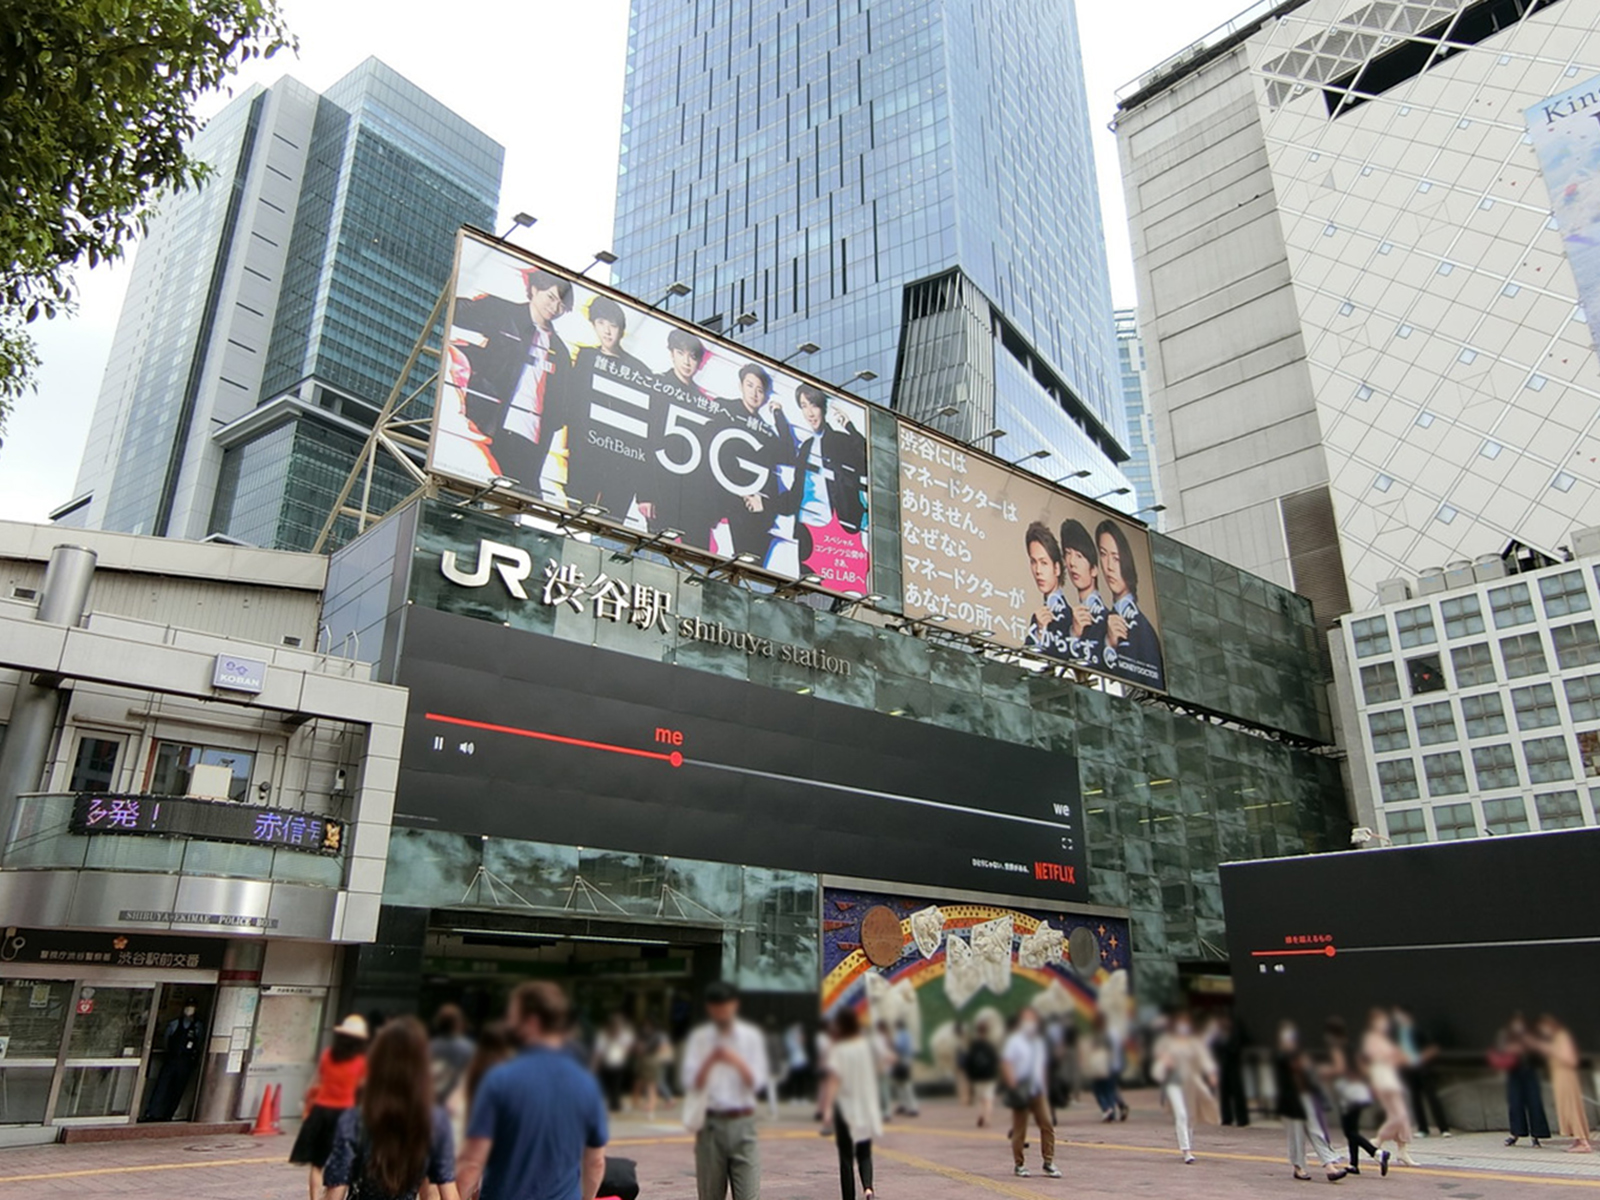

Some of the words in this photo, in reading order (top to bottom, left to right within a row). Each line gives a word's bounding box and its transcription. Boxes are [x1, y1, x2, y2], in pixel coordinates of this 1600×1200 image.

[594, 355, 773, 437] 誰も見たことのない世界へ、一緒に。
[587, 429, 647, 462] SoftBank
[655, 403, 773, 498] 5G
[900, 428, 968, 475] 渋谷には
[900, 461, 1018, 523] マネードクターは
[902, 488, 986, 540] ありません。
[903, 519, 972, 563] なぜなら
[440, 538, 533, 600] JR
[543, 556, 672, 635] 渋谷駅
[821, 567, 834, 579] 5G
[904, 554, 1026, 610] マネードクターが
[679, 614, 775, 658] shibuya
[781, 642, 853, 677] station
[905, 583, 1099, 664] あなたの所へ行くからです。
[655, 725, 683, 746] me
[1053, 802, 1070, 816] we
[1034, 861, 1075, 885] NETFLIX
[218, 915, 251, 926] POLICE
[117, 951, 200, 968] 渋谷駅前交番
